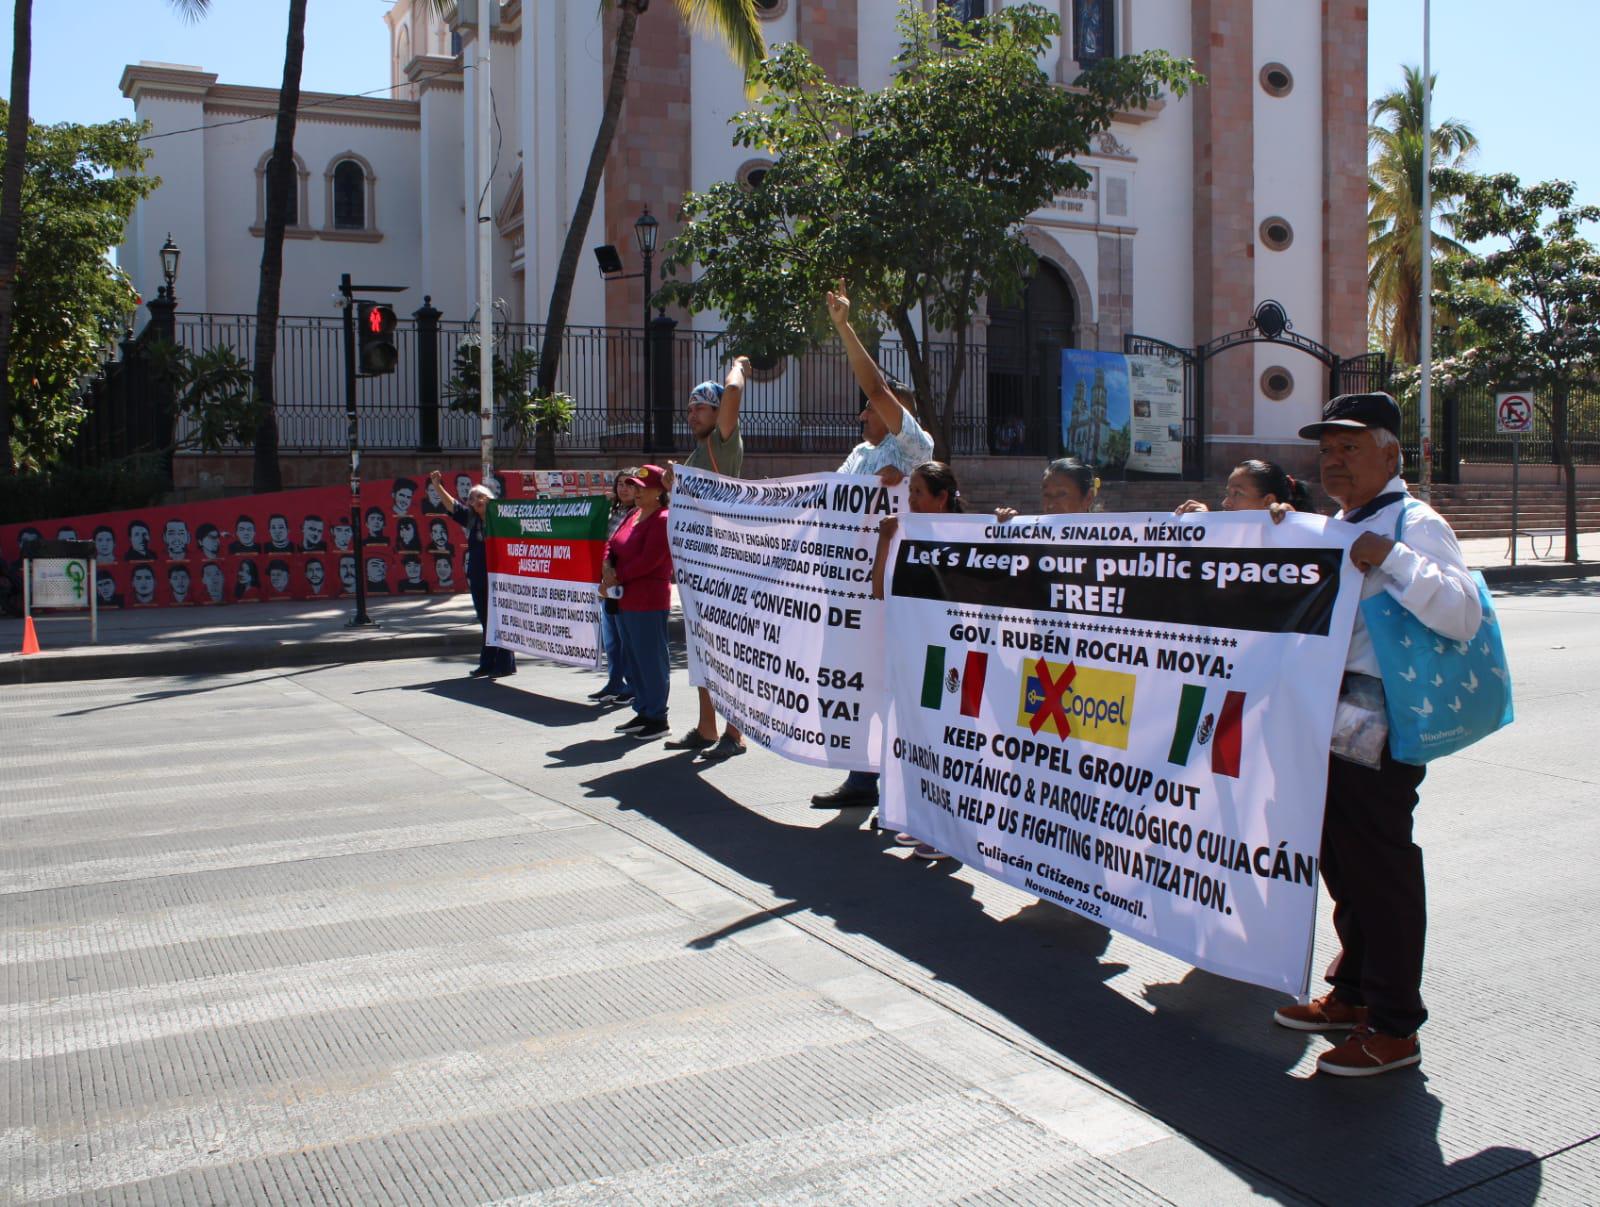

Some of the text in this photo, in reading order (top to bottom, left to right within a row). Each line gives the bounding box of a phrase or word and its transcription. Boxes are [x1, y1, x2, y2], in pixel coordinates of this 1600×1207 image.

[832, 484, 899, 515] MOYA:
[507, 541, 571, 560] RUBÉN ROCHA MOYA
[680, 521, 686, 533] 2
[686, 521, 706, 537] AÑOS
[745, 532, 780, 550] ENGAÑOS
[781, 538, 791, 551] DE
[800, 540, 873, 566] GOBIERNO,
[984, 522, 1206, 543] CULIACÁN, SINALOA, MÉXICO
[684, 538, 719, 558] SEGUIMOS,
[720, 546, 761, 565] DEFENDIENDO
[762, 553, 770, 568] LA
[771, 555, 810, 575] PROPIEDAD
[966, 547, 1030, 577] keep
[1038, 555, 1087, 575] our
[1096, 551, 1192, 582] public
[1200, 560, 1321, 589] spaces
[549, 588, 567, 601] BIENES
[731, 584, 748, 605] DEL
[827, 606, 862, 630] DE
[1050, 583, 1126, 615] FREE!
[762, 621, 781, 645] YA!
[949, 623, 1234, 680] GOV. RUBÉN ROCHA MOYA:
[715, 634, 731, 657] DEL
[733, 640, 782, 675] DECRETO
[785, 658, 810, 684] No.
[816, 666, 865, 692] 584
[736, 670, 754, 694] DEL
[757, 679, 809, 714] ESTADO
[817, 697, 860, 722] YA!
[748, 706, 770, 729] PARQUE
[771, 718, 826, 746] ECOLÓGICO
[829, 734, 851, 750] DE
[943, 725, 1201, 811] KEEP COPPEL GROUP OUT
[892, 736, 1314, 888] OF JARDÍN BOTÁNICO & PARQUE ECOLÓGICO CULIACÁN
[920, 777, 1232, 916] PLEASE, HELP US FIGHTING PRIVATIZATION.
[976, 841, 1147, 920] Culiacán Citizens Council.
[1024, 877, 1103, 919] November 2023.
